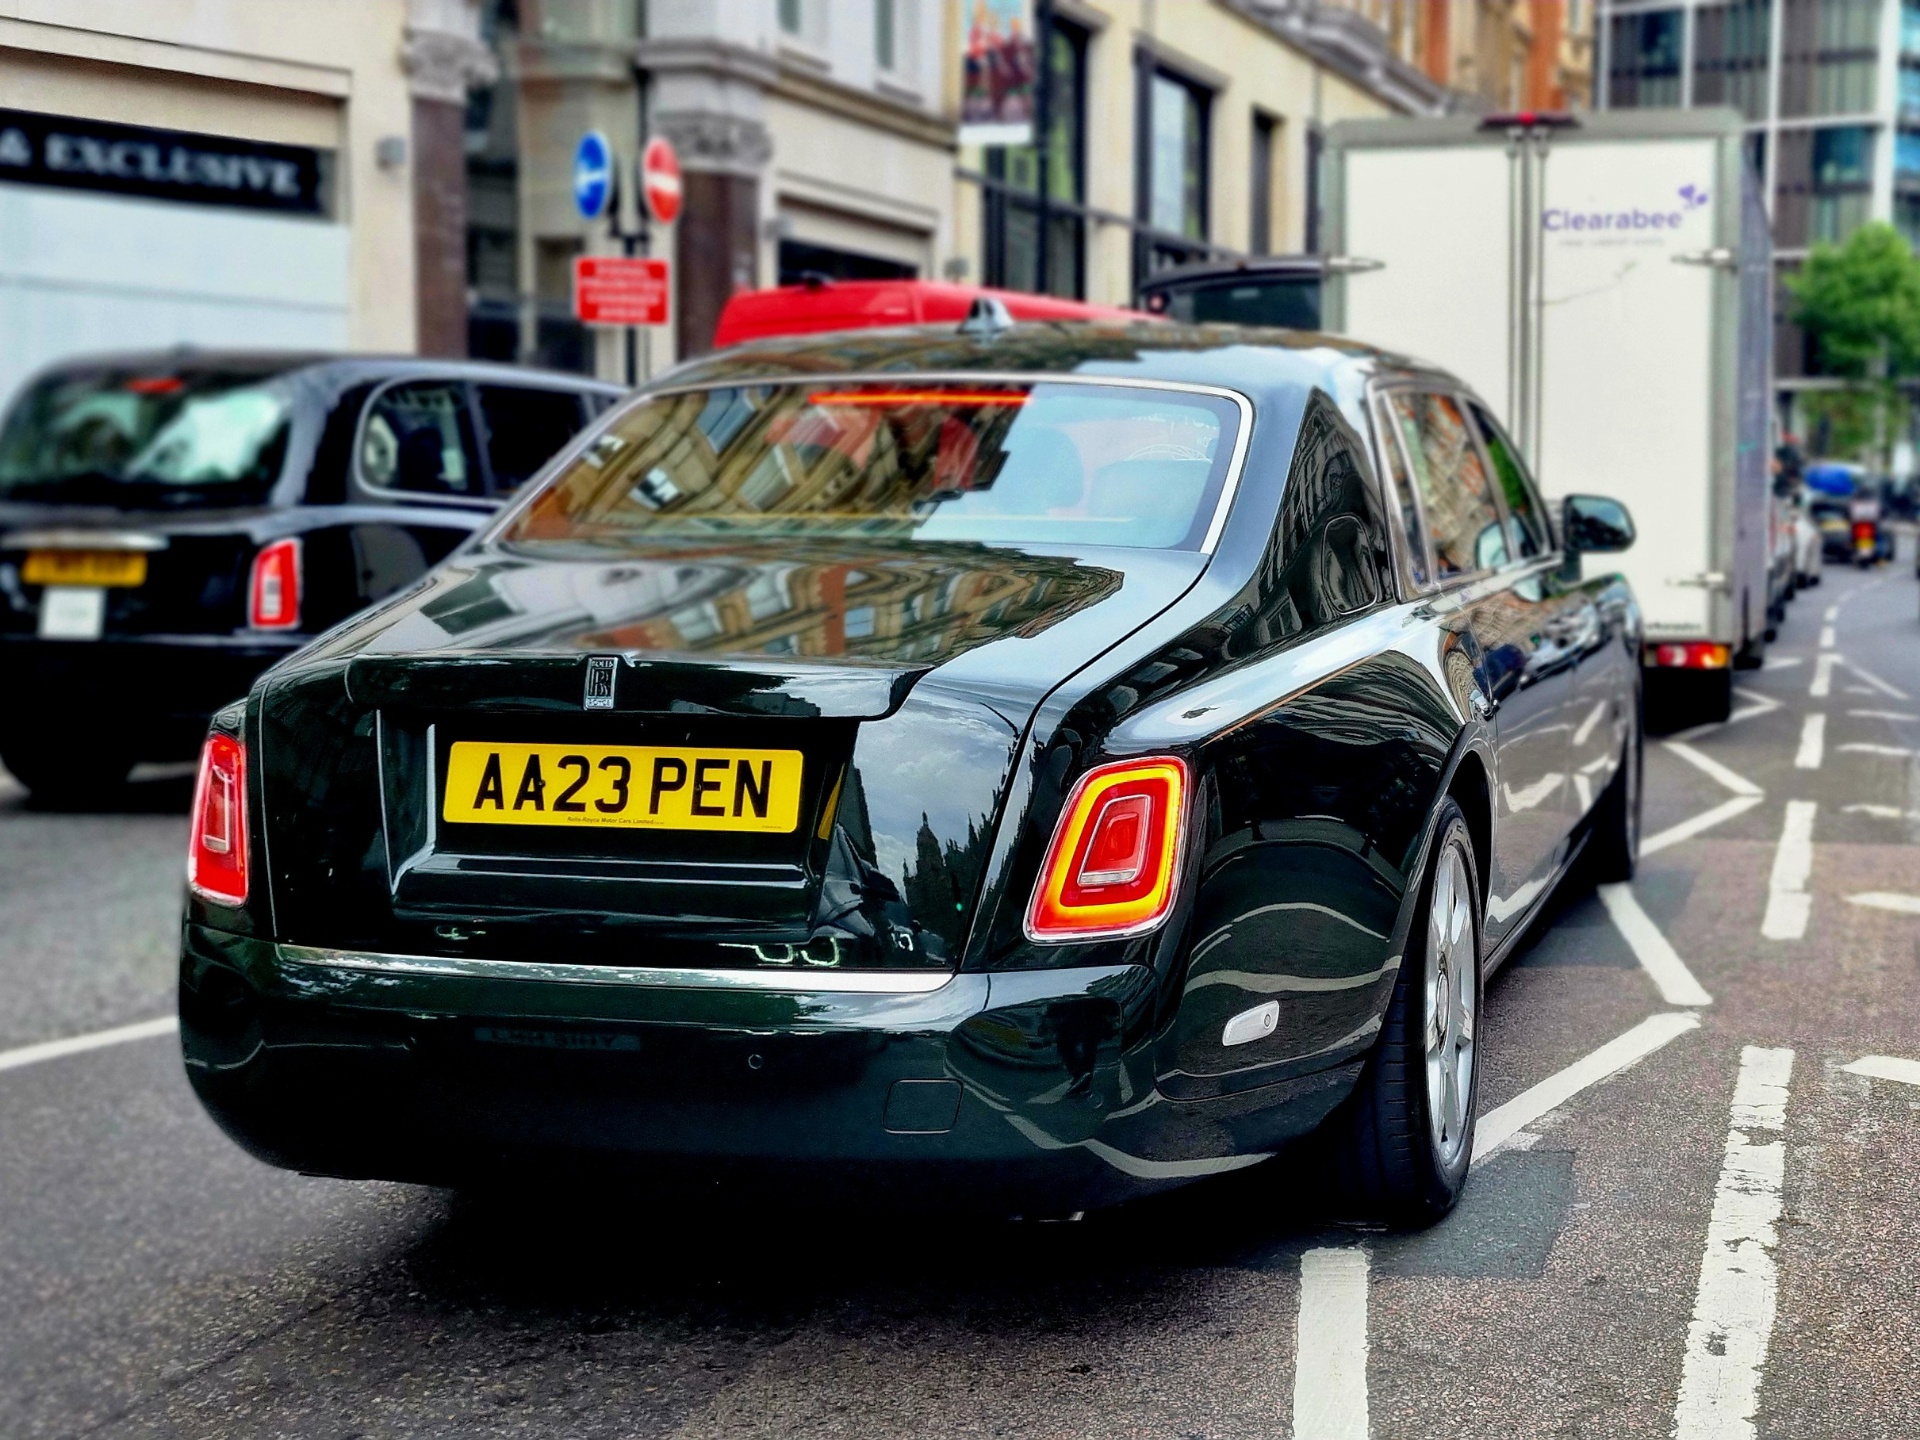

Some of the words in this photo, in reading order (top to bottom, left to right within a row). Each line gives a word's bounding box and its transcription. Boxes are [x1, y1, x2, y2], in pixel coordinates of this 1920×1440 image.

[44, 132, 301, 196] EXCLUSIVE
[1542, 208, 1682, 232] Clearabee
[472, 752, 632, 814] AA23
[648, 757, 773, 818] PEN
[567, 816, 600, 824] Rolls-Royce
